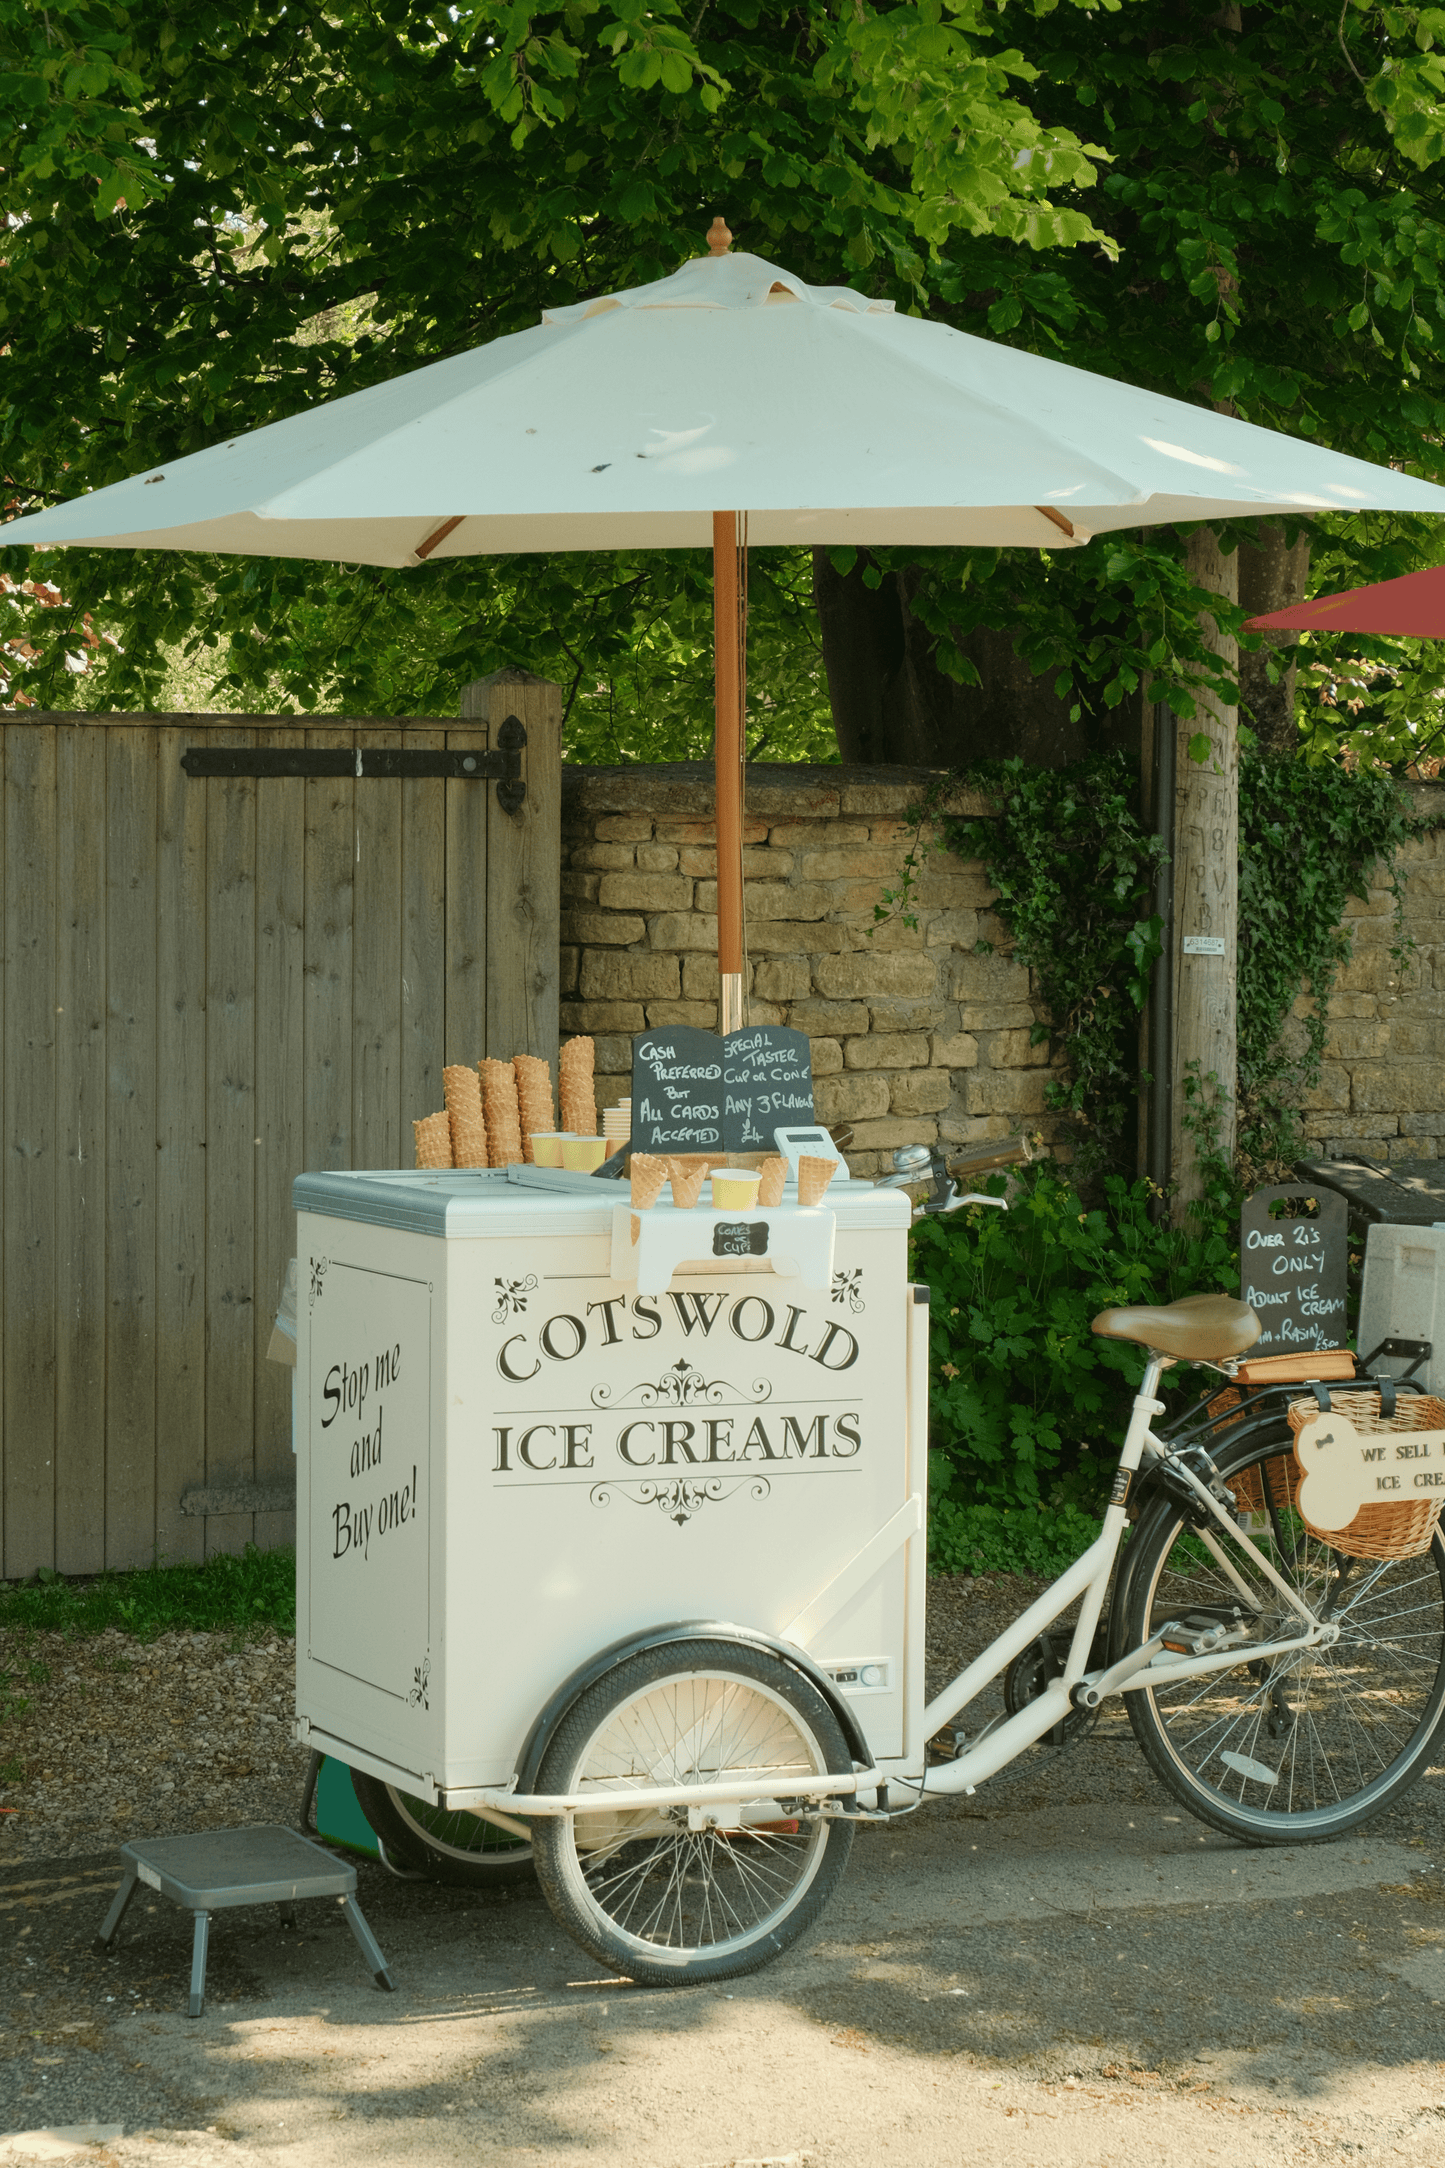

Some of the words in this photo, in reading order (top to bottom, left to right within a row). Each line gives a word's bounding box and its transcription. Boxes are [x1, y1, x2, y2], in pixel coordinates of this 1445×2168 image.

[639, 1042, 676, 1061] CASH
[724, 1033, 773, 1059] SPECIAL
[742, 1048, 799, 1067] TASTER
[650, 1061, 722, 1081] PREFERRED
[770, 1066, 810, 1082] CONE
[663, 1086, 690, 1100] BUT
[640, 1098, 663, 1123] ALL
[671, 1104, 720, 1121] CARDS
[725, 1095, 752, 1117] ANY
[757, 1095, 771, 1114] 3
[651, 1126, 720, 1145] ACCEPTED
[741, 1117, 764, 1144] £4
[1246, 1230, 1285, 1250] OVER
[1272, 1251, 1325, 1275] ONLY
[1246, 1285, 1291, 1308] ADULT
[1297, 1284, 1320, 1301] ICE
[1301, 1298, 1345, 1316] CREAM
[496, 1291, 860, 1384] COTSWOLD
[1281, 1317, 1319, 1343] RASIN
[321, 1362, 369, 1429] Stop
[375, 1343, 401, 1392] me
[350, 1405, 383, 1479] and
[491, 1424, 595, 1472] ICE
[616, 1412, 863, 1466] CREAMS
[1360, 1446, 1387, 1462] WE
[1396, 1444, 1431, 1460] SELL
[1376, 1475, 1401, 1491] ICE
[1413, 1472, 1445, 1488] CRE
[332, 1502, 373, 1561] Buy
[378, 1464, 417, 1536] one!
